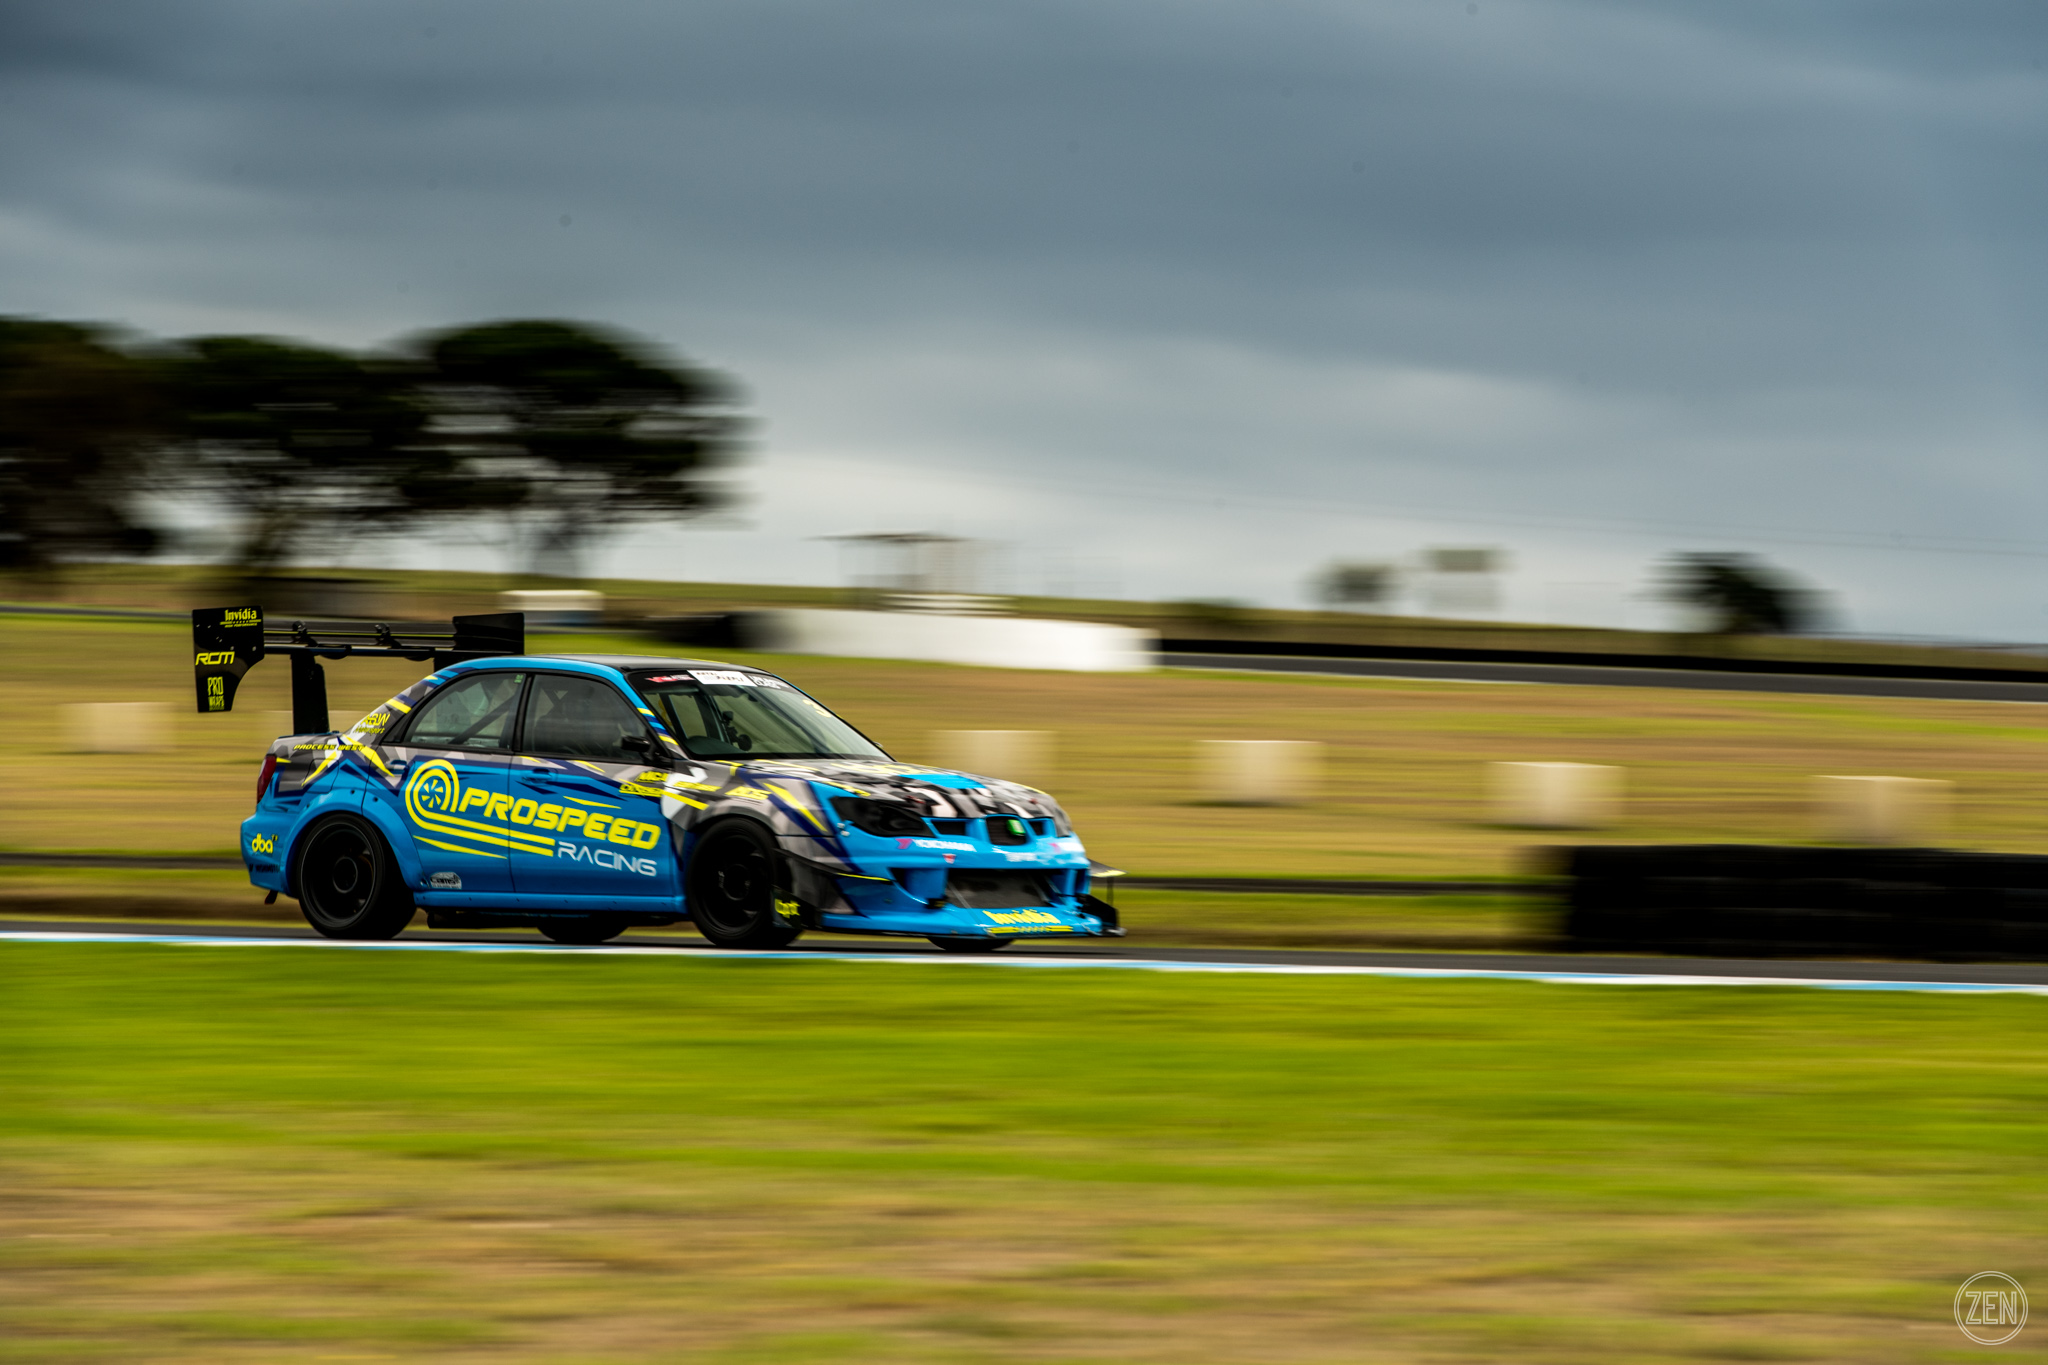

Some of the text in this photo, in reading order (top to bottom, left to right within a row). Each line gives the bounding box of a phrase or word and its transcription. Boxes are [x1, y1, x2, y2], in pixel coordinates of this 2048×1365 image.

[224, 608, 257, 621] Invidia
[195, 651, 235, 665] RCM
[207, 676, 224, 695] PRO
[293, 743, 366, 751] PROCESS WEST
[458, 787, 661, 850] PROSPEED
[252, 833, 273, 853] dba
[558, 841, 657, 877] RACING
